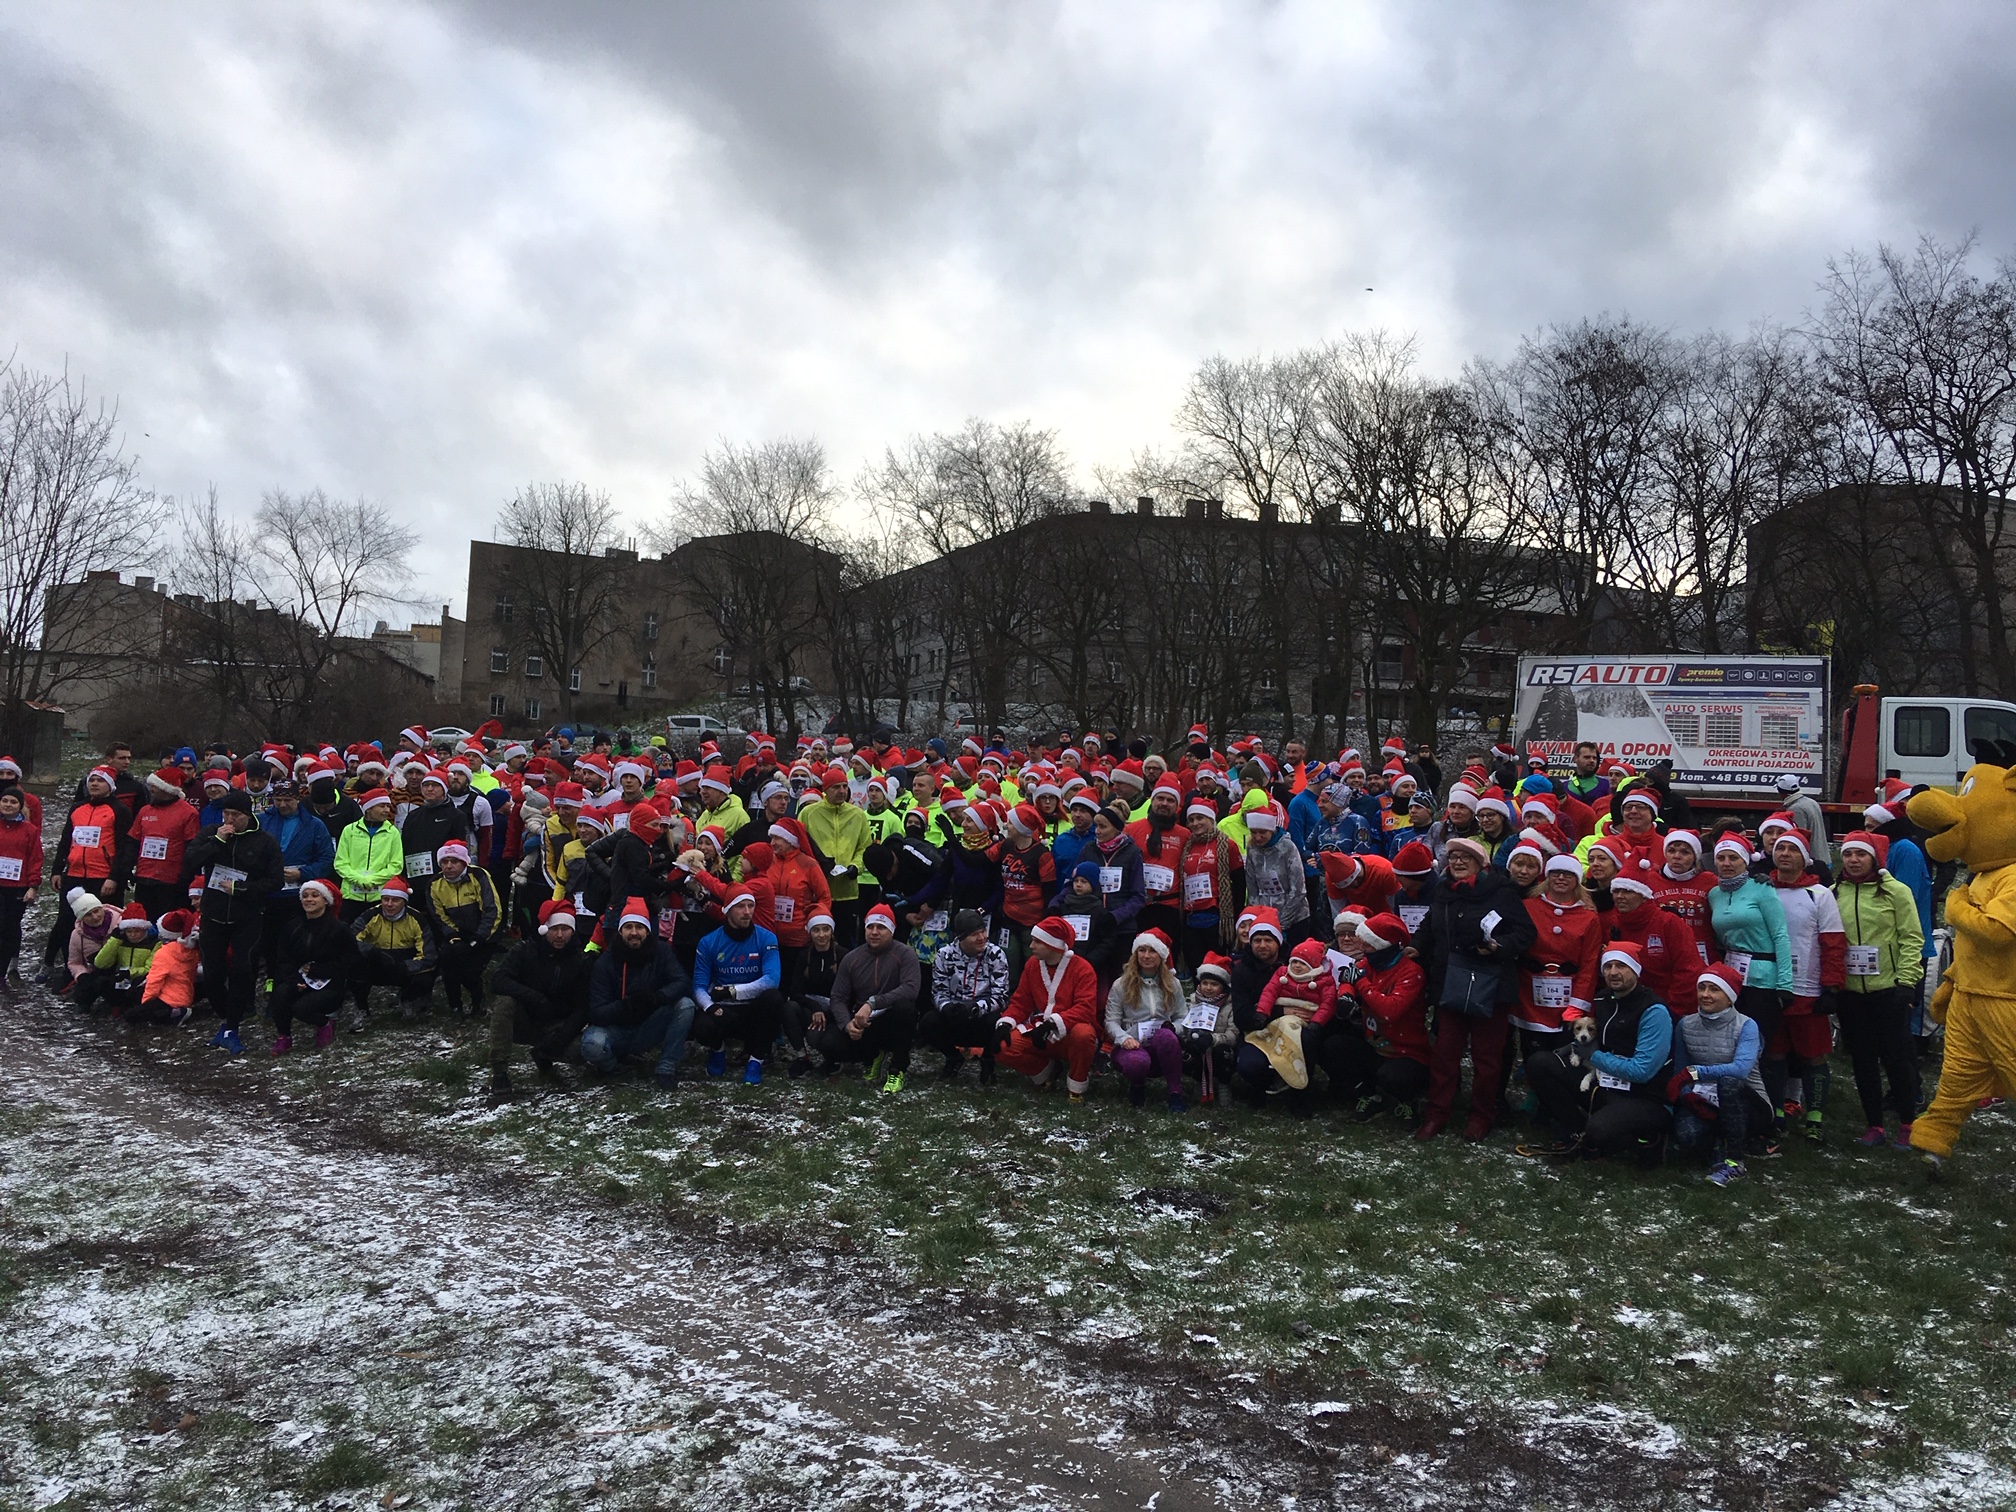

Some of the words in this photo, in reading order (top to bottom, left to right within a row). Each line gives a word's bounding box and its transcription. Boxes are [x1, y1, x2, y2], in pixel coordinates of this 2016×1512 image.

[1686, 667, 1724, 677] premio
[1665, 705, 1696, 713] AUTO
[1700, 705, 1743, 714] SERWIS
[1621, 743, 1672, 757] OPON
[1708, 750, 1768, 759] OKRĘGOWA
[1771, 751, 1810, 759] STACJA
[1703, 759, 1754, 767] KONTROLI
[1757, 760, 1815, 769] POJAZDÓW
[1680, 772, 1707, 781] kom.
[1711, 774, 1732, 782] +48
[1735, 774, 1757, 782] 698
[1002, 853, 1030, 875] FUCK
[718, 965, 759, 974] WITKOWO
[1547, 986, 1559, 994] 164
